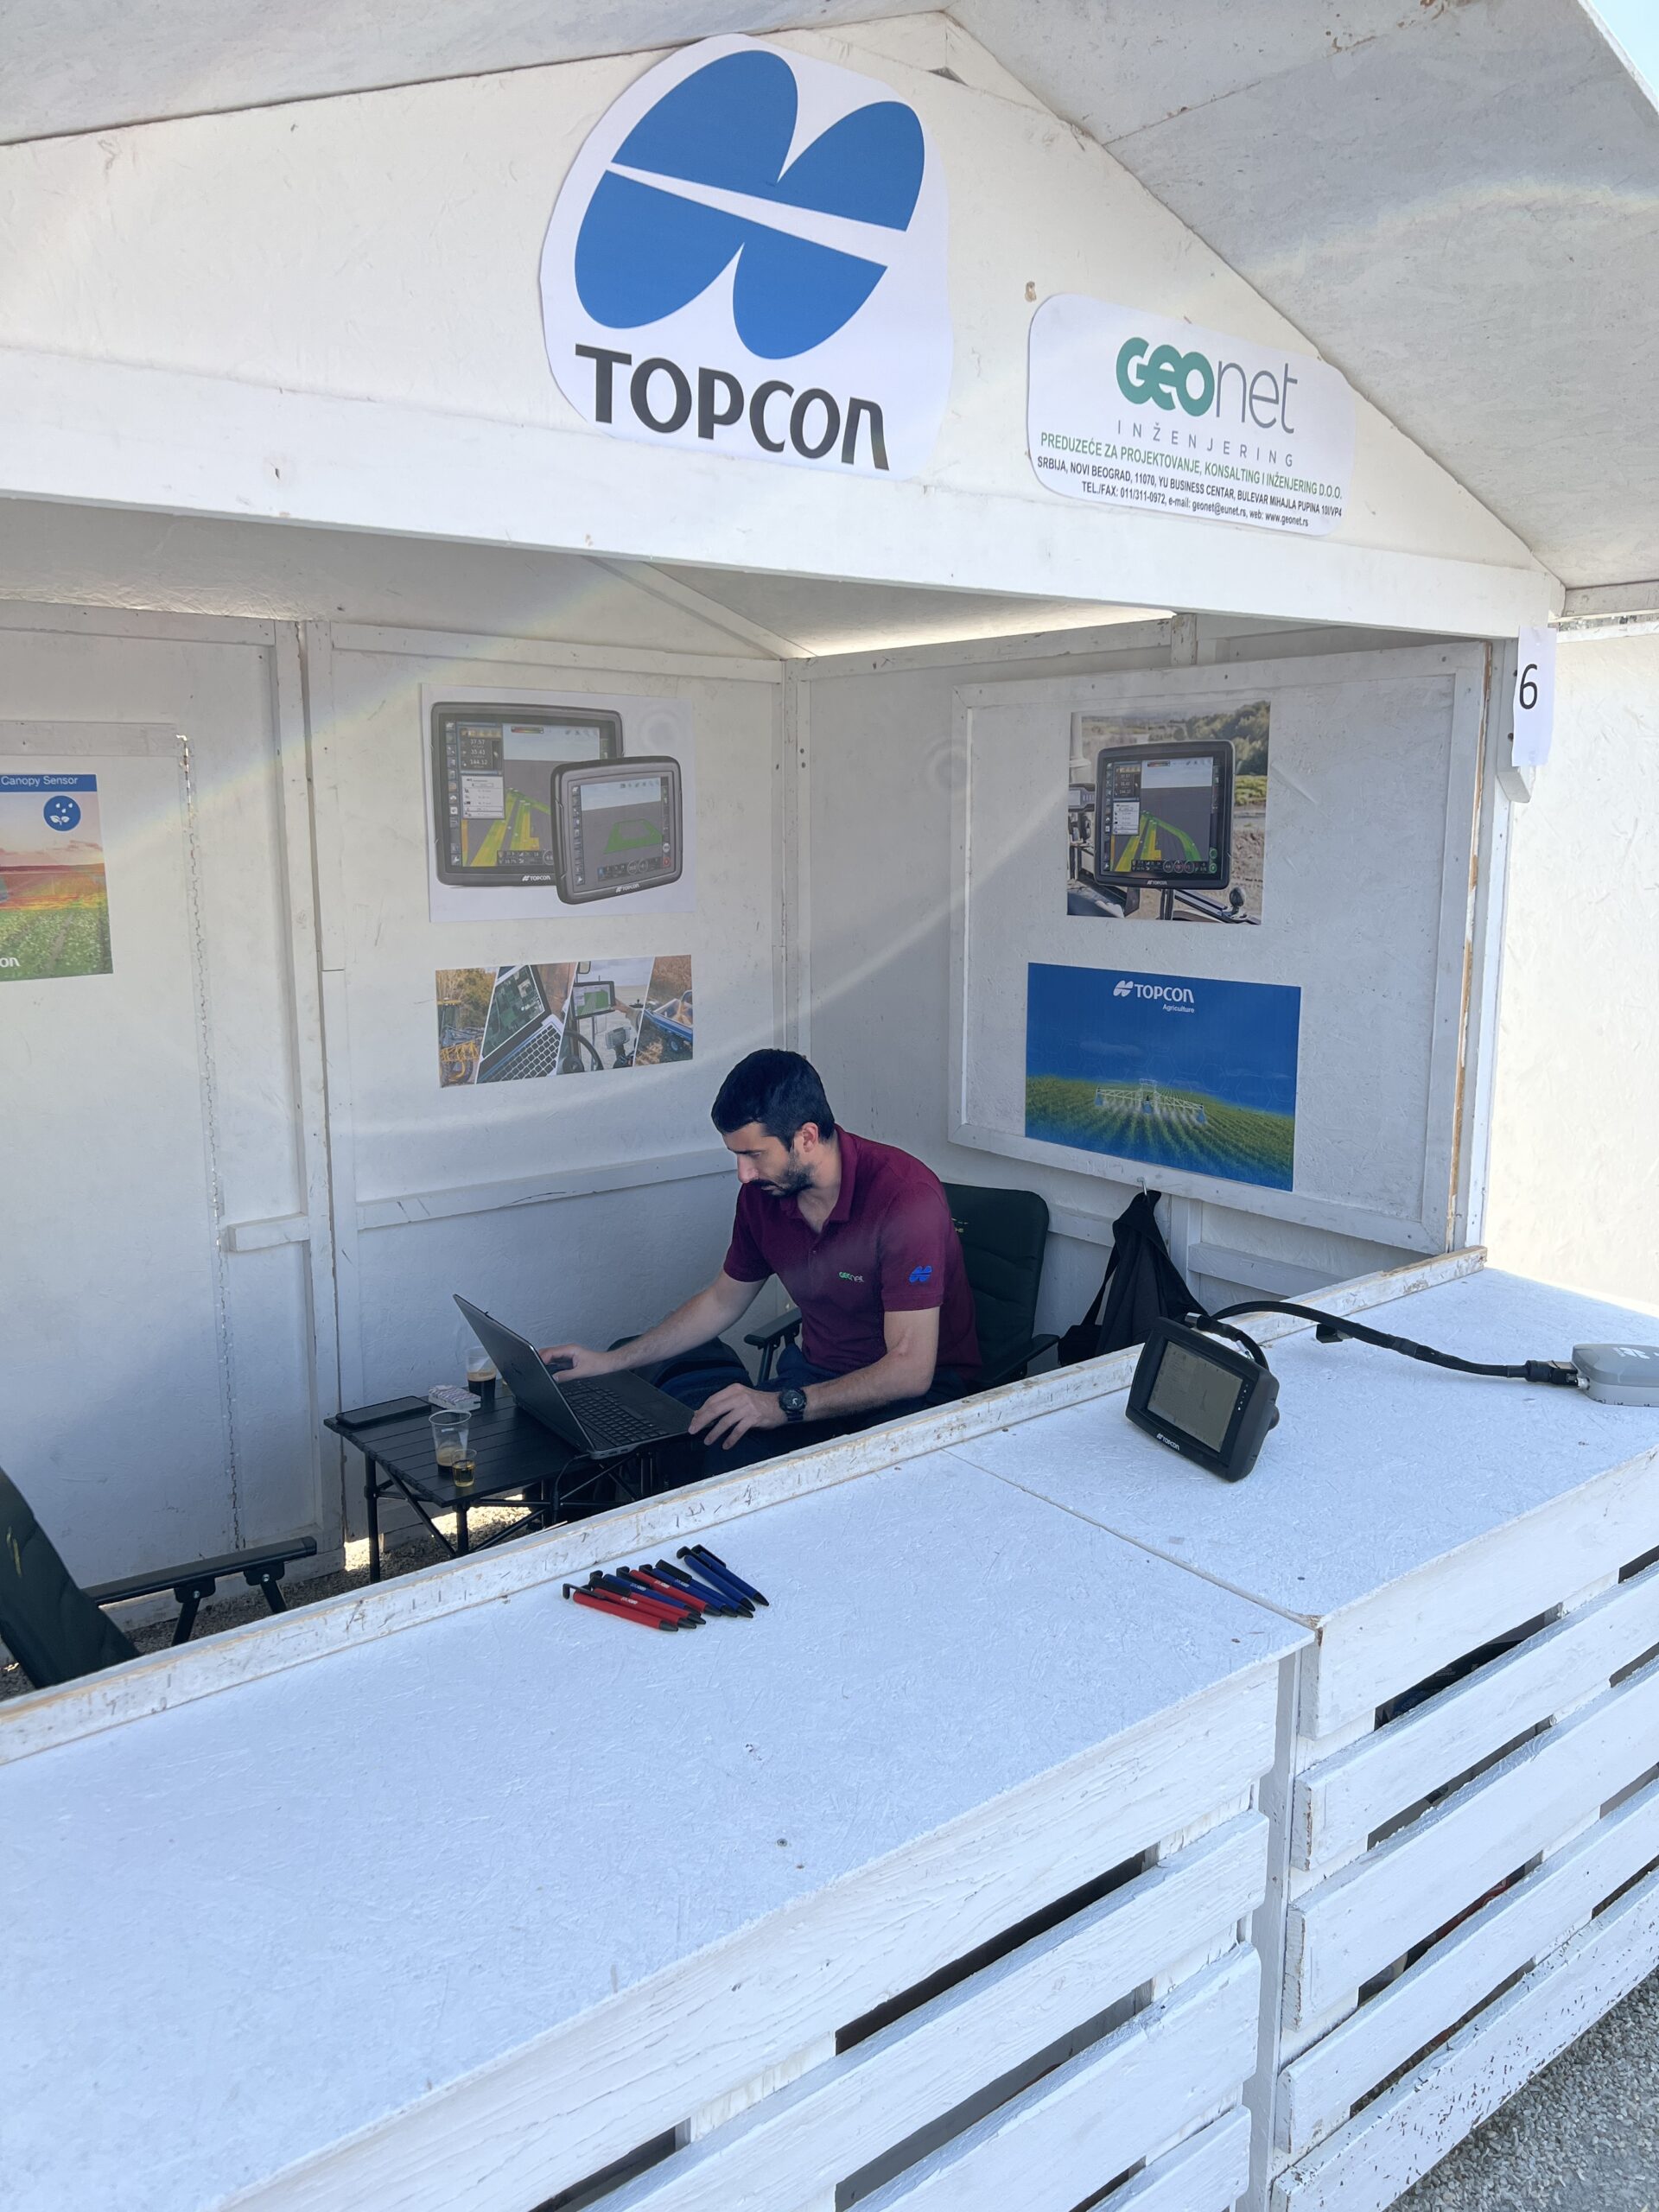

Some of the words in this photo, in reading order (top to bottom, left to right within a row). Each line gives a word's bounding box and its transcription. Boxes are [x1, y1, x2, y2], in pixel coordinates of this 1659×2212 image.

[575, 343, 890, 471] TOPCON
[1040, 431, 1103, 457] PREDUZEĆE
[1104, 443, 1118, 460] ZA
[1121, 446, 1203, 476] PROJEKTOVANJE,
[1205, 461, 1261, 485] KONSALTING
[1266, 471, 1318, 495] INŽENJERING
[1319, 483, 1343, 499] D.O.O.
[1117, 419, 1294, 467] INŽENJERING
[1037, 455, 1069, 474] SRBIJA,
[1070, 461, 1090, 479] NOVI
[1091, 465, 1133, 484] BEOGRAD,
[1135, 472, 1157, 488] 11070,
[1159, 476, 1169, 488] YU
[1170, 478, 1205, 495] BUSINESS
[1206, 484, 1236, 501] CENTAR,
[1237, 489, 1268, 505] BULEVAR
[1269, 495, 1297, 511] MIHAJLA
[1298, 499, 1320, 515] PUPINA
[1082, 480, 1119, 498] TEL./FAX:
[1168, 495, 1192, 509] e-mail:
[1192, 499, 1249, 519] geonet@eunet.rs,
[1249, 508, 1263, 520] web:
[1265, 511, 1309, 527] www.geonet.rs
[1519, 663, 1538, 710] 6
[0, 775, 41, 787] Canopy
[43, 775, 79, 785] Sensor
[1134, 983, 1195, 1004] TOPCON
[1162, 1003, 1195, 1014] Agriculture
